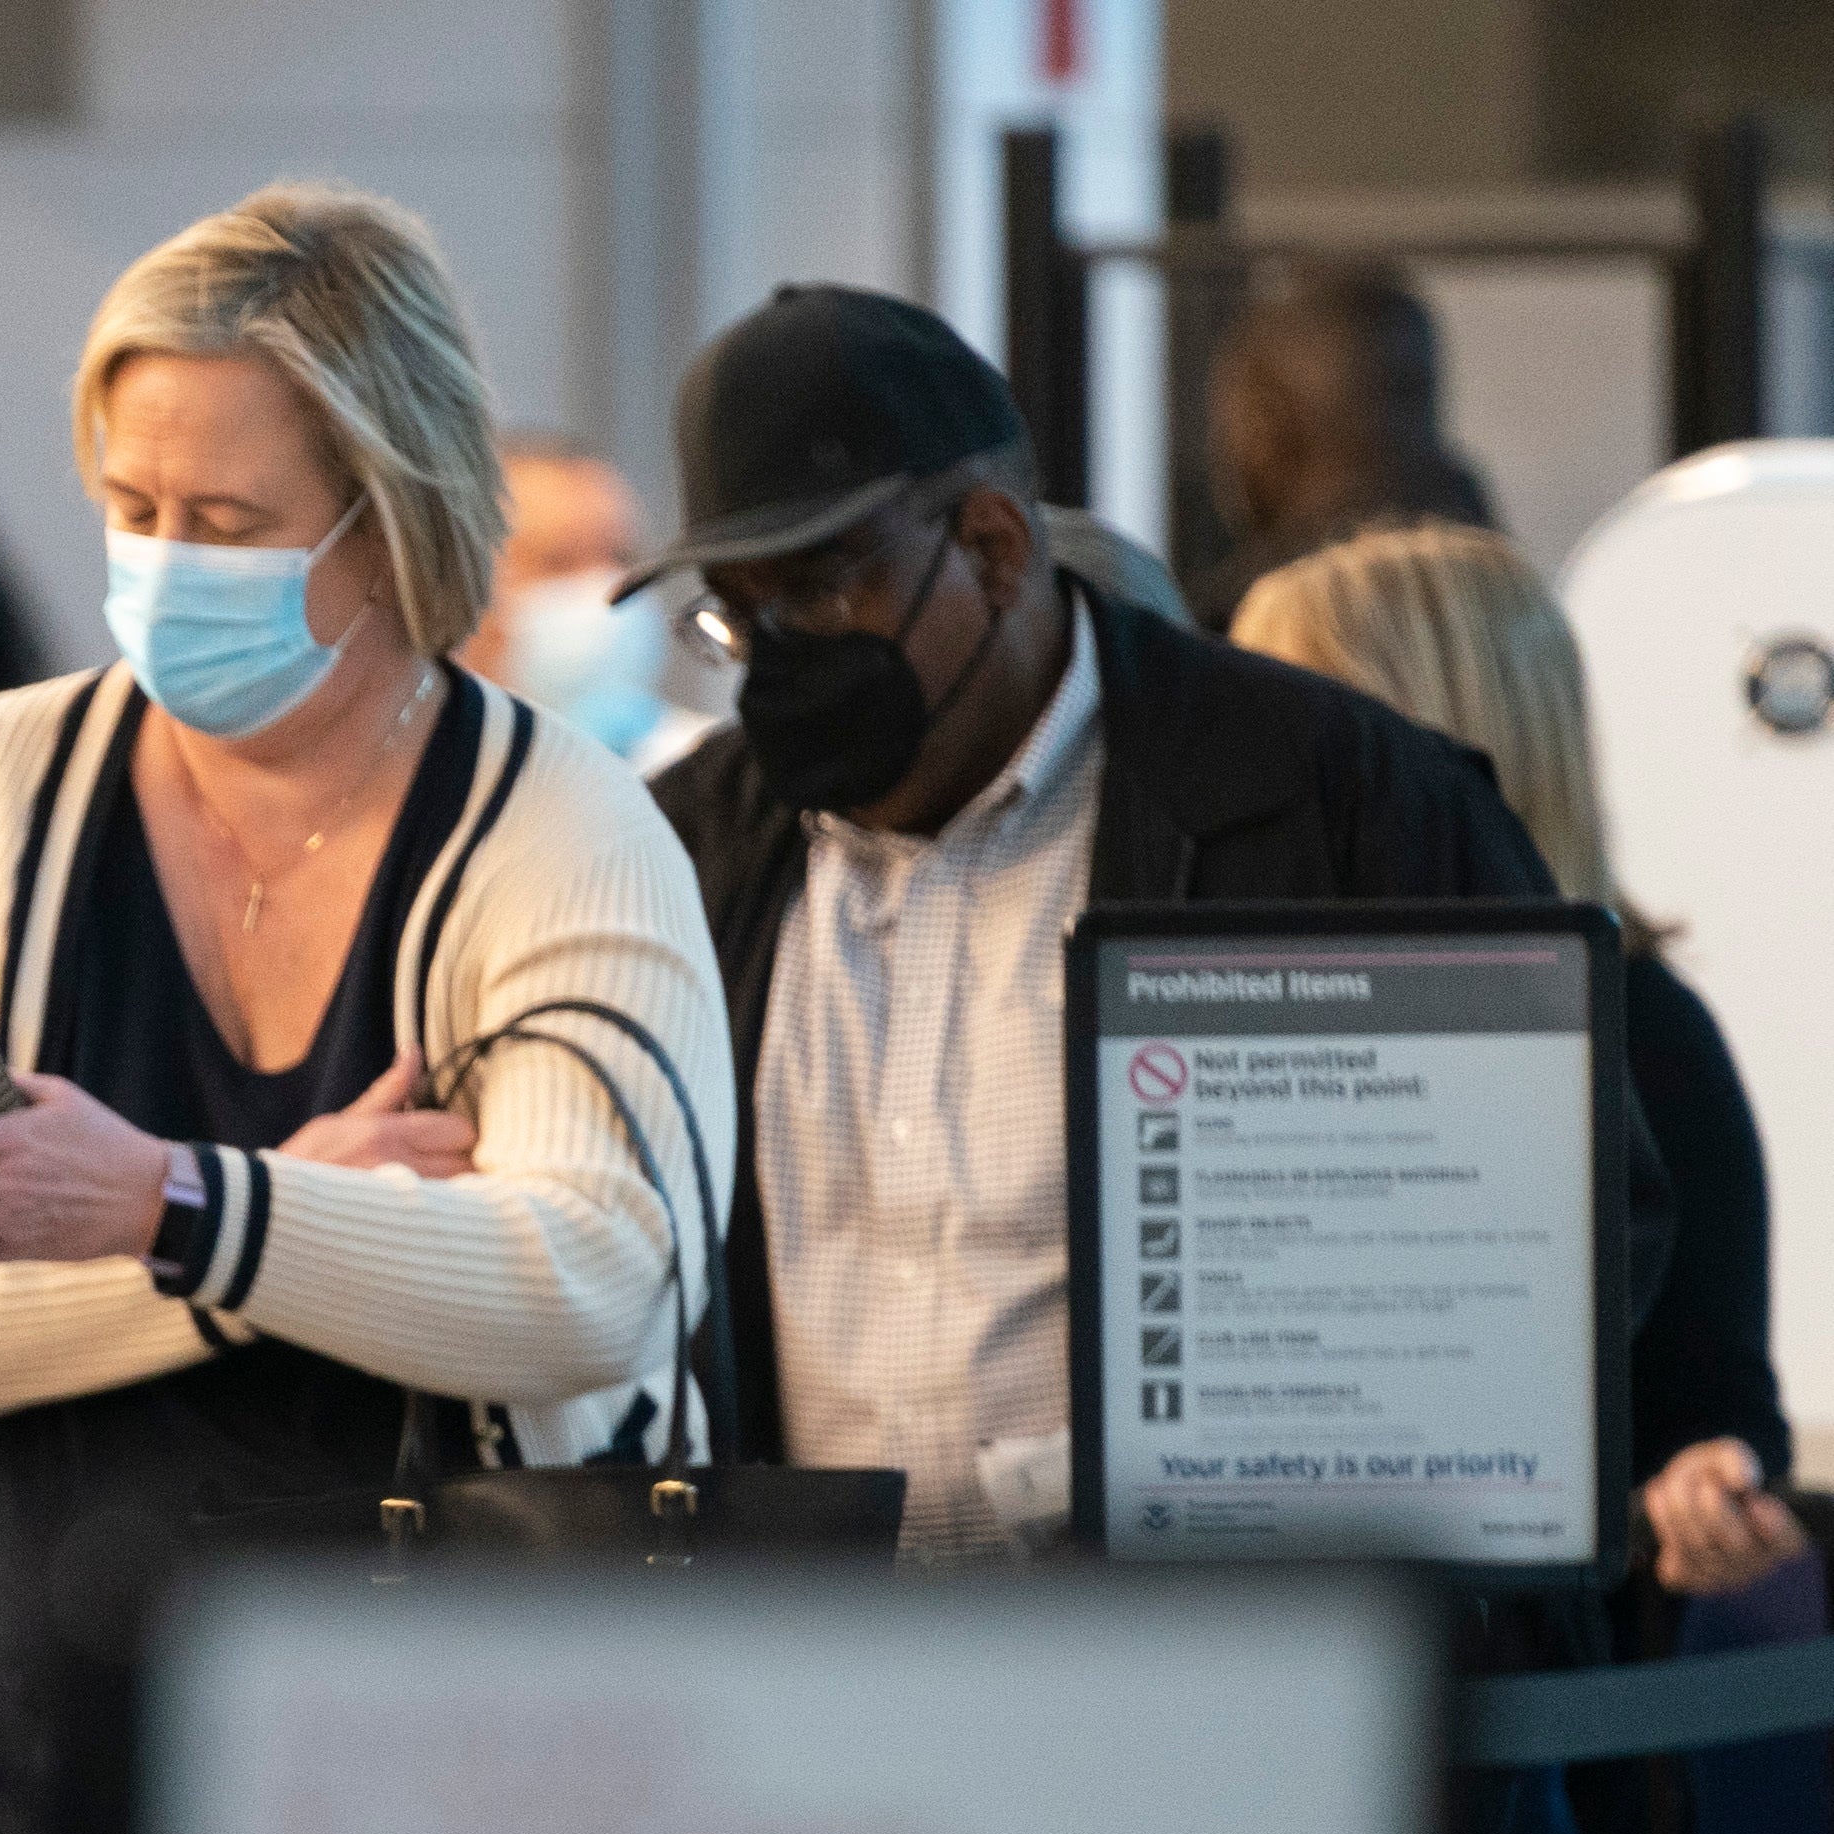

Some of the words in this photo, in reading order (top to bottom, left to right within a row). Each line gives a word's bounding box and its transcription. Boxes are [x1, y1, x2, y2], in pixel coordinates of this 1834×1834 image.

[1128, 970, 1284, 1003] Prohibited
[1289, 971, 1372, 1001] Items
[1194, 1049, 1239, 1070] Not
[1247, 1047, 1378, 1073] permitted
[1194, 1074, 1292, 1102] beyond
[1298, 1075, 1347, 1097] this
[1159, 1453, 1225, 1479] Your
[1236, 1452, 1326, 1482] safety
[1336, 1452, 1360, 1477] is
[1366, 1456, 1414, 1478] our
[1424, 1449, 1540, 1484] priority
